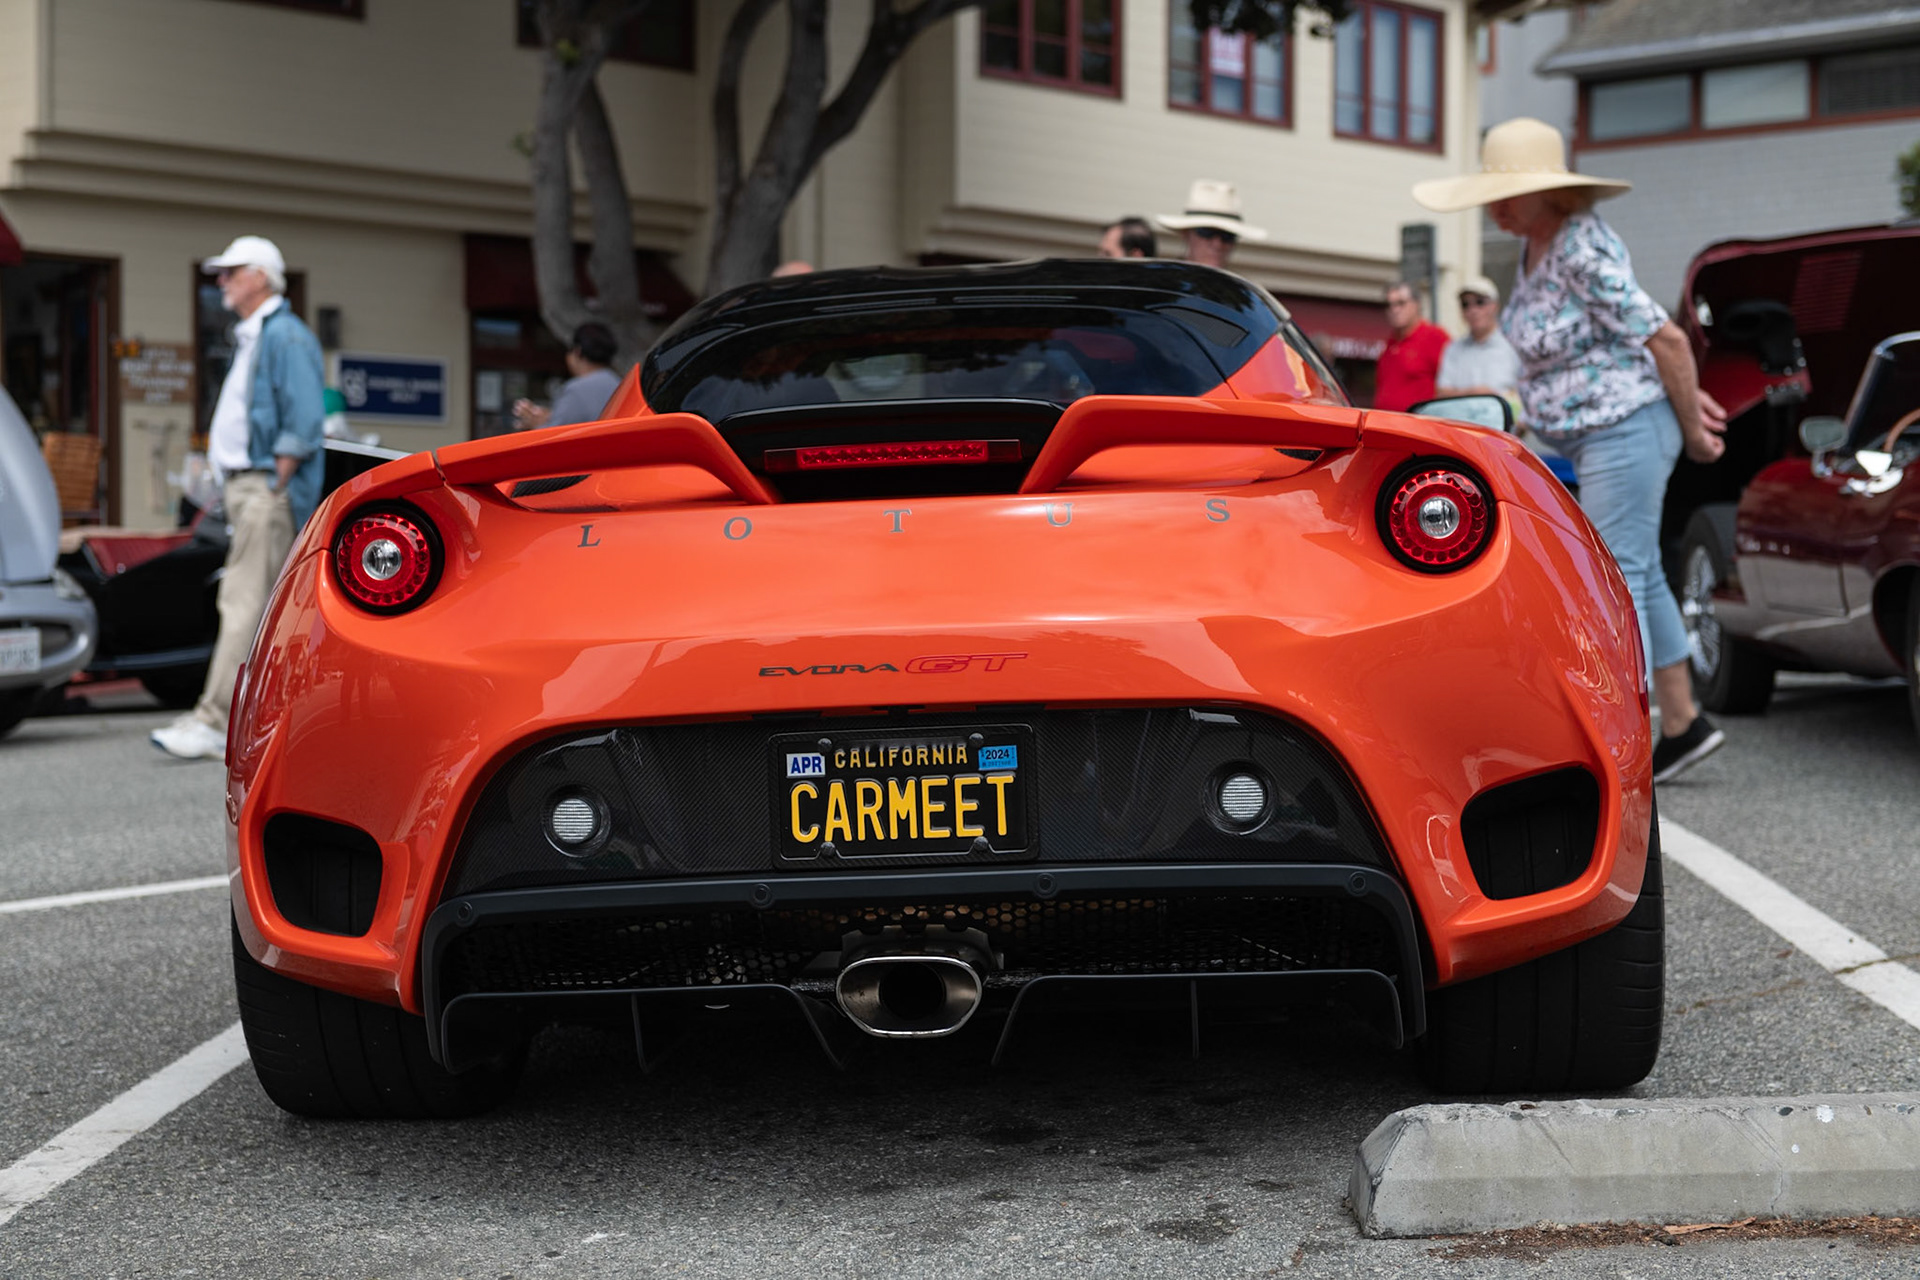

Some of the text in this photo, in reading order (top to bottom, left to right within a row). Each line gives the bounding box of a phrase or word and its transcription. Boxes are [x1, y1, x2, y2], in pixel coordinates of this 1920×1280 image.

[577, 498, 1231, 548] LOTUS
[759, 652, 1029, 677] EVORA GT
[790, 756, 822, 775] APR
[834, 746, 968, 769] CALIFORNIA
[985, 749, 1010, 760] 2024
[790, 775, 1015, 843] CARMEET
